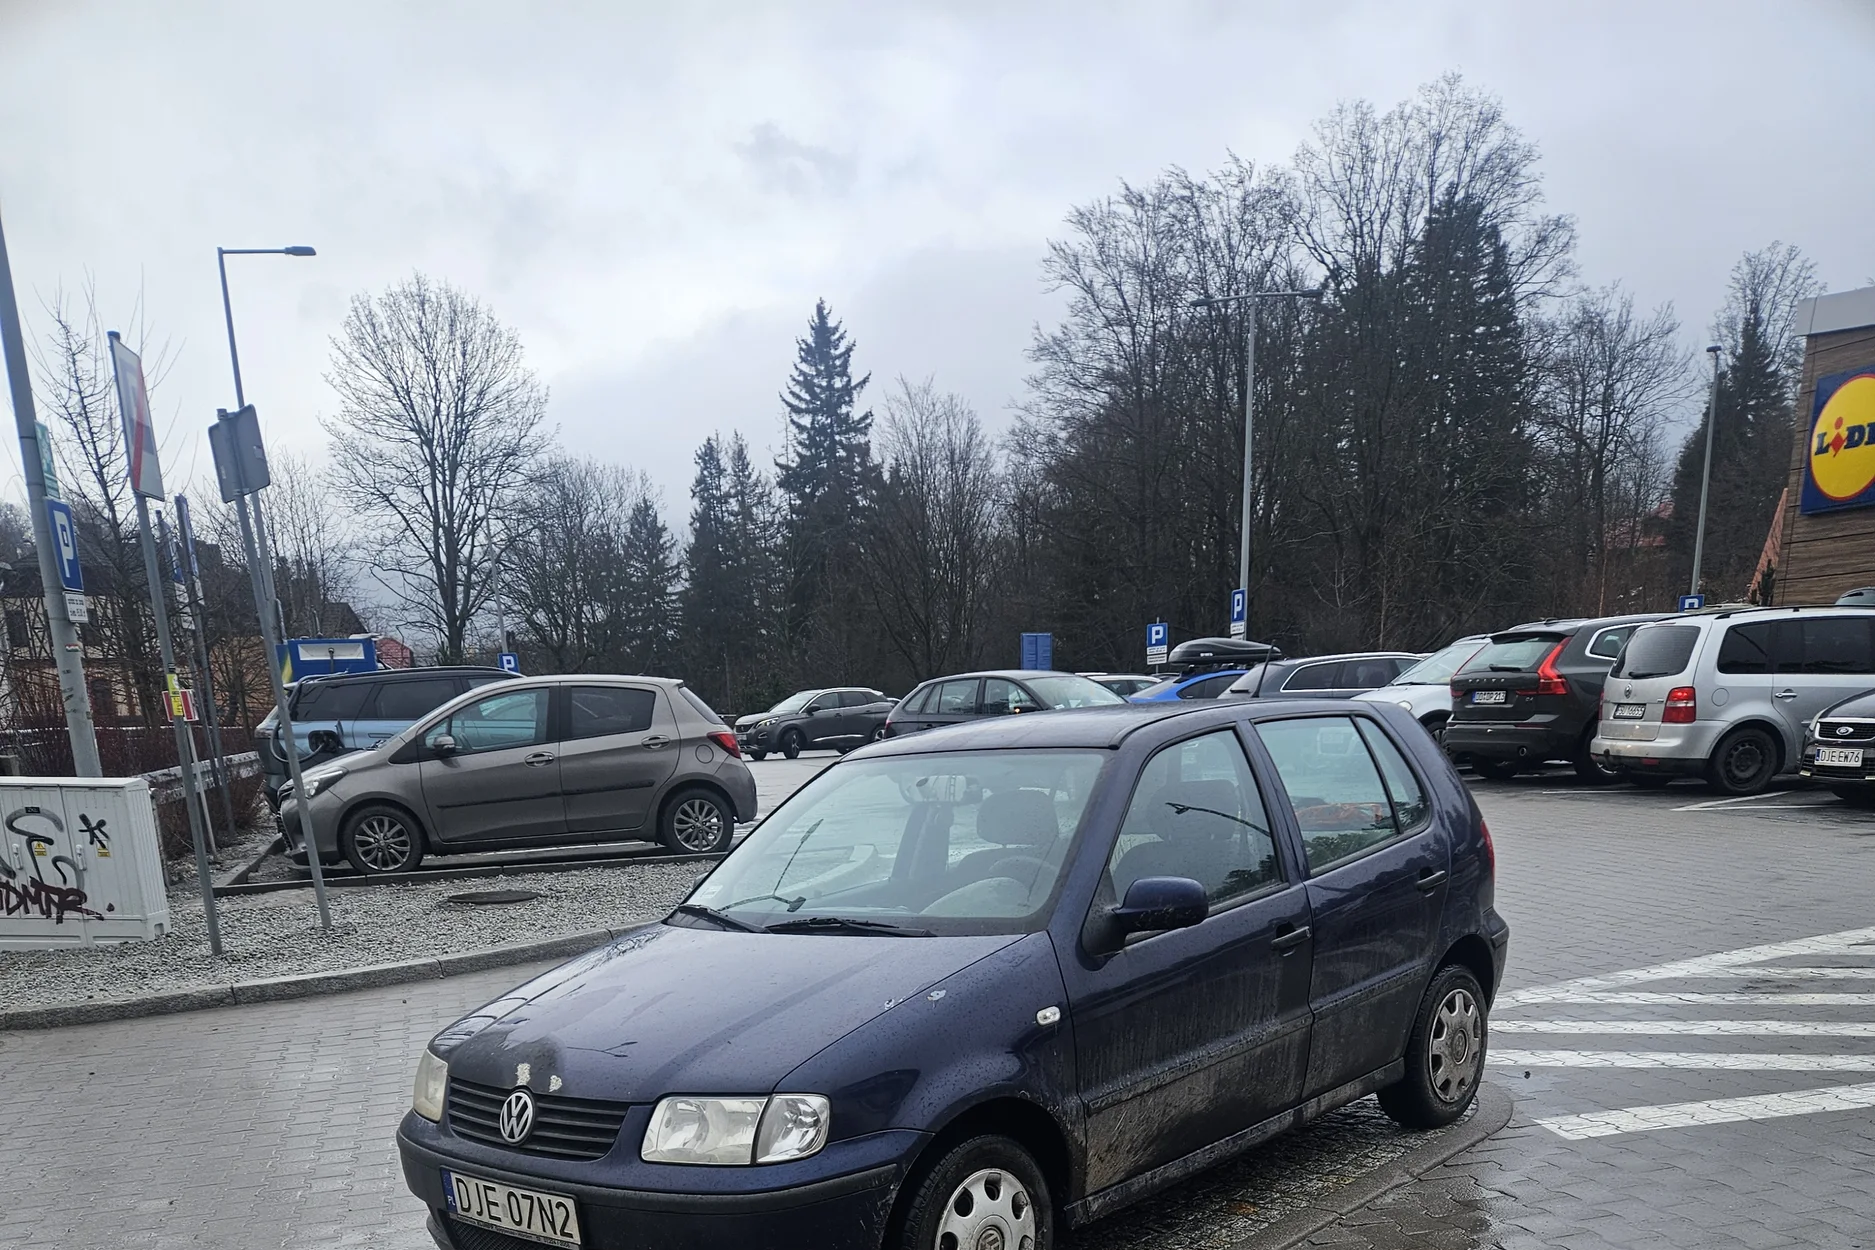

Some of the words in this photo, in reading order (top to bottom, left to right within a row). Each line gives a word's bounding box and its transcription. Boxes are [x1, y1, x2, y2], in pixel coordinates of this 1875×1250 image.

[53, 510, 74, 578] P
[1233, 594, 1243, 619] P
[1151, 626, 1164, 644] P
[502, 656, 515, 670] P
[1821, 750, 1837, 762] DJE
[1838, 751, 1860, 763] EW76
[455, 1177, 502, 1222] DJE
[507, 1190, 574, 1239] 07N2
